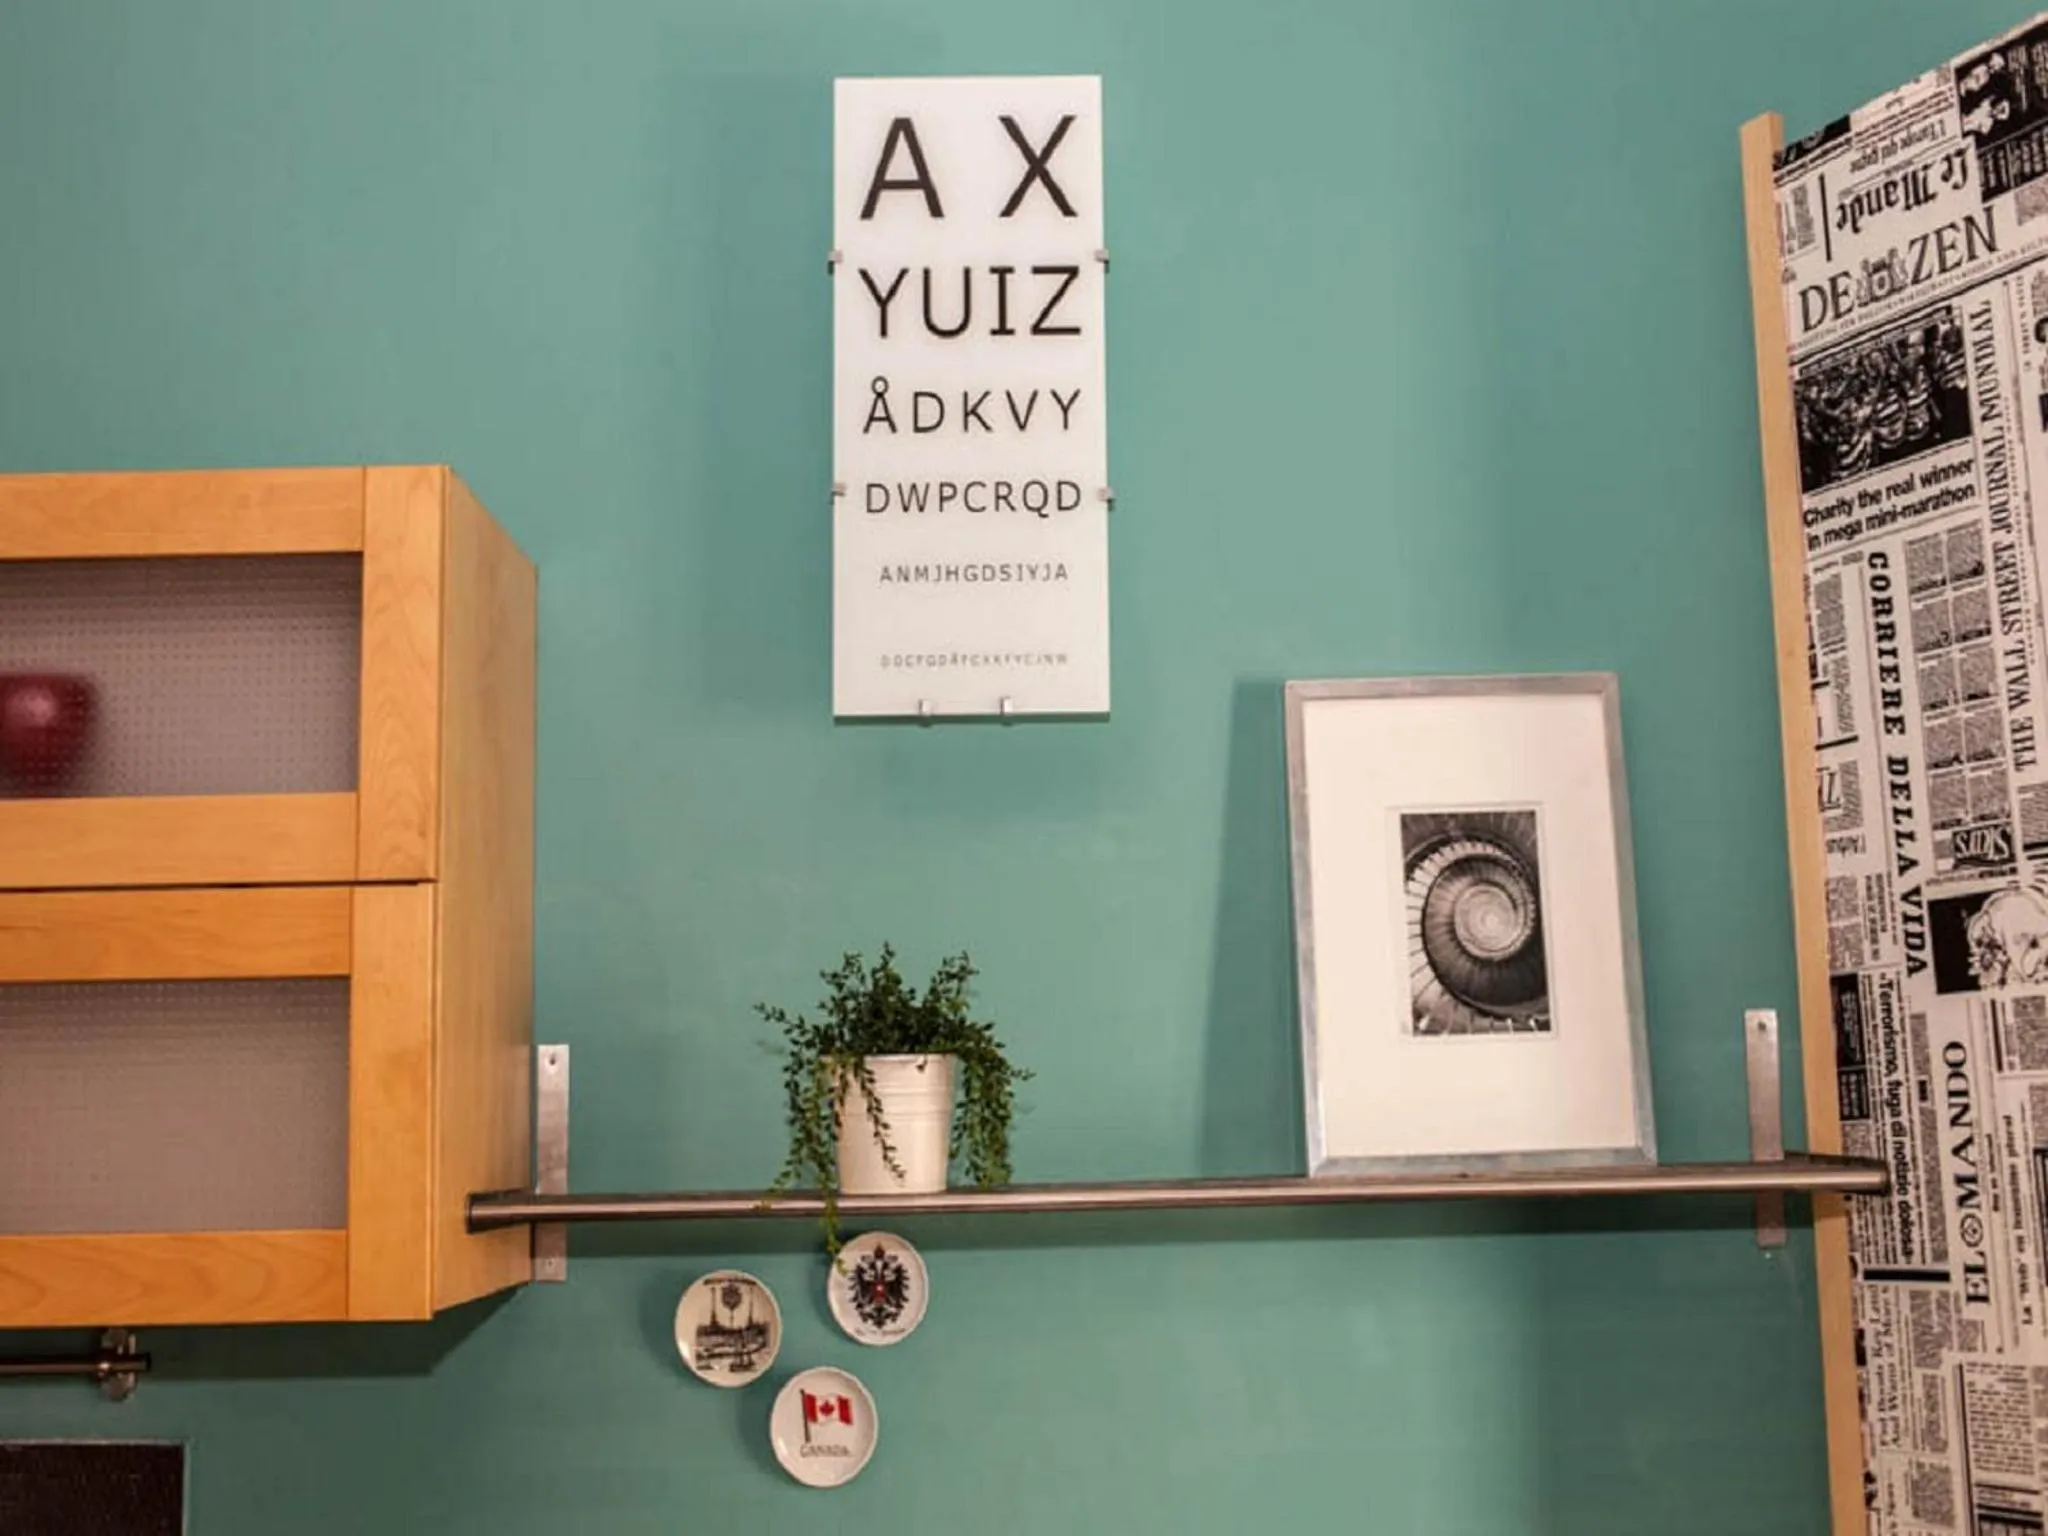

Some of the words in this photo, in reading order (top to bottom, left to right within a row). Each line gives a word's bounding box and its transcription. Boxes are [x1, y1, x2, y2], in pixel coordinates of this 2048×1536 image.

[859, 116, 945, 220] A
[997, 114, 1079, 218] X
[857, 264, 1082, 340] YUIZ
[1797, 270, 1855, 333] DE
[1907, 203, 2001, 286] ZEN
[1968, 298, 2004, 424] MUNDIAL
[862, 375, 1082, 434] ÅDKVY
[865, 479, 1083, 519] DWPCRQD
[1803, 496, 1856, 528] Charity
[1857, 487, 1883, 509] the
[1885, 472, 1916, 500] real
[1918, 457, 1975, 489] winner
[1807, 532, 1822, 551] in
[1823, 519, 1864, 545] mega
[1865, 483, 1977, 531] mini-marathon
[1980, 427, 2013, 536] JOURNAL
[1992, 541, 2025, 637] STREET
[1867, 552, 1907, 736] CORRIERE
[2003, 640, 2032, 711] WALL
[2010, 716, 2038, 773] THE
[1886, 755, 1919, 877] DELLA
[1899, 883, 1930, 979] VIDA
[1884, 1079, 1904, 1118] fuga
